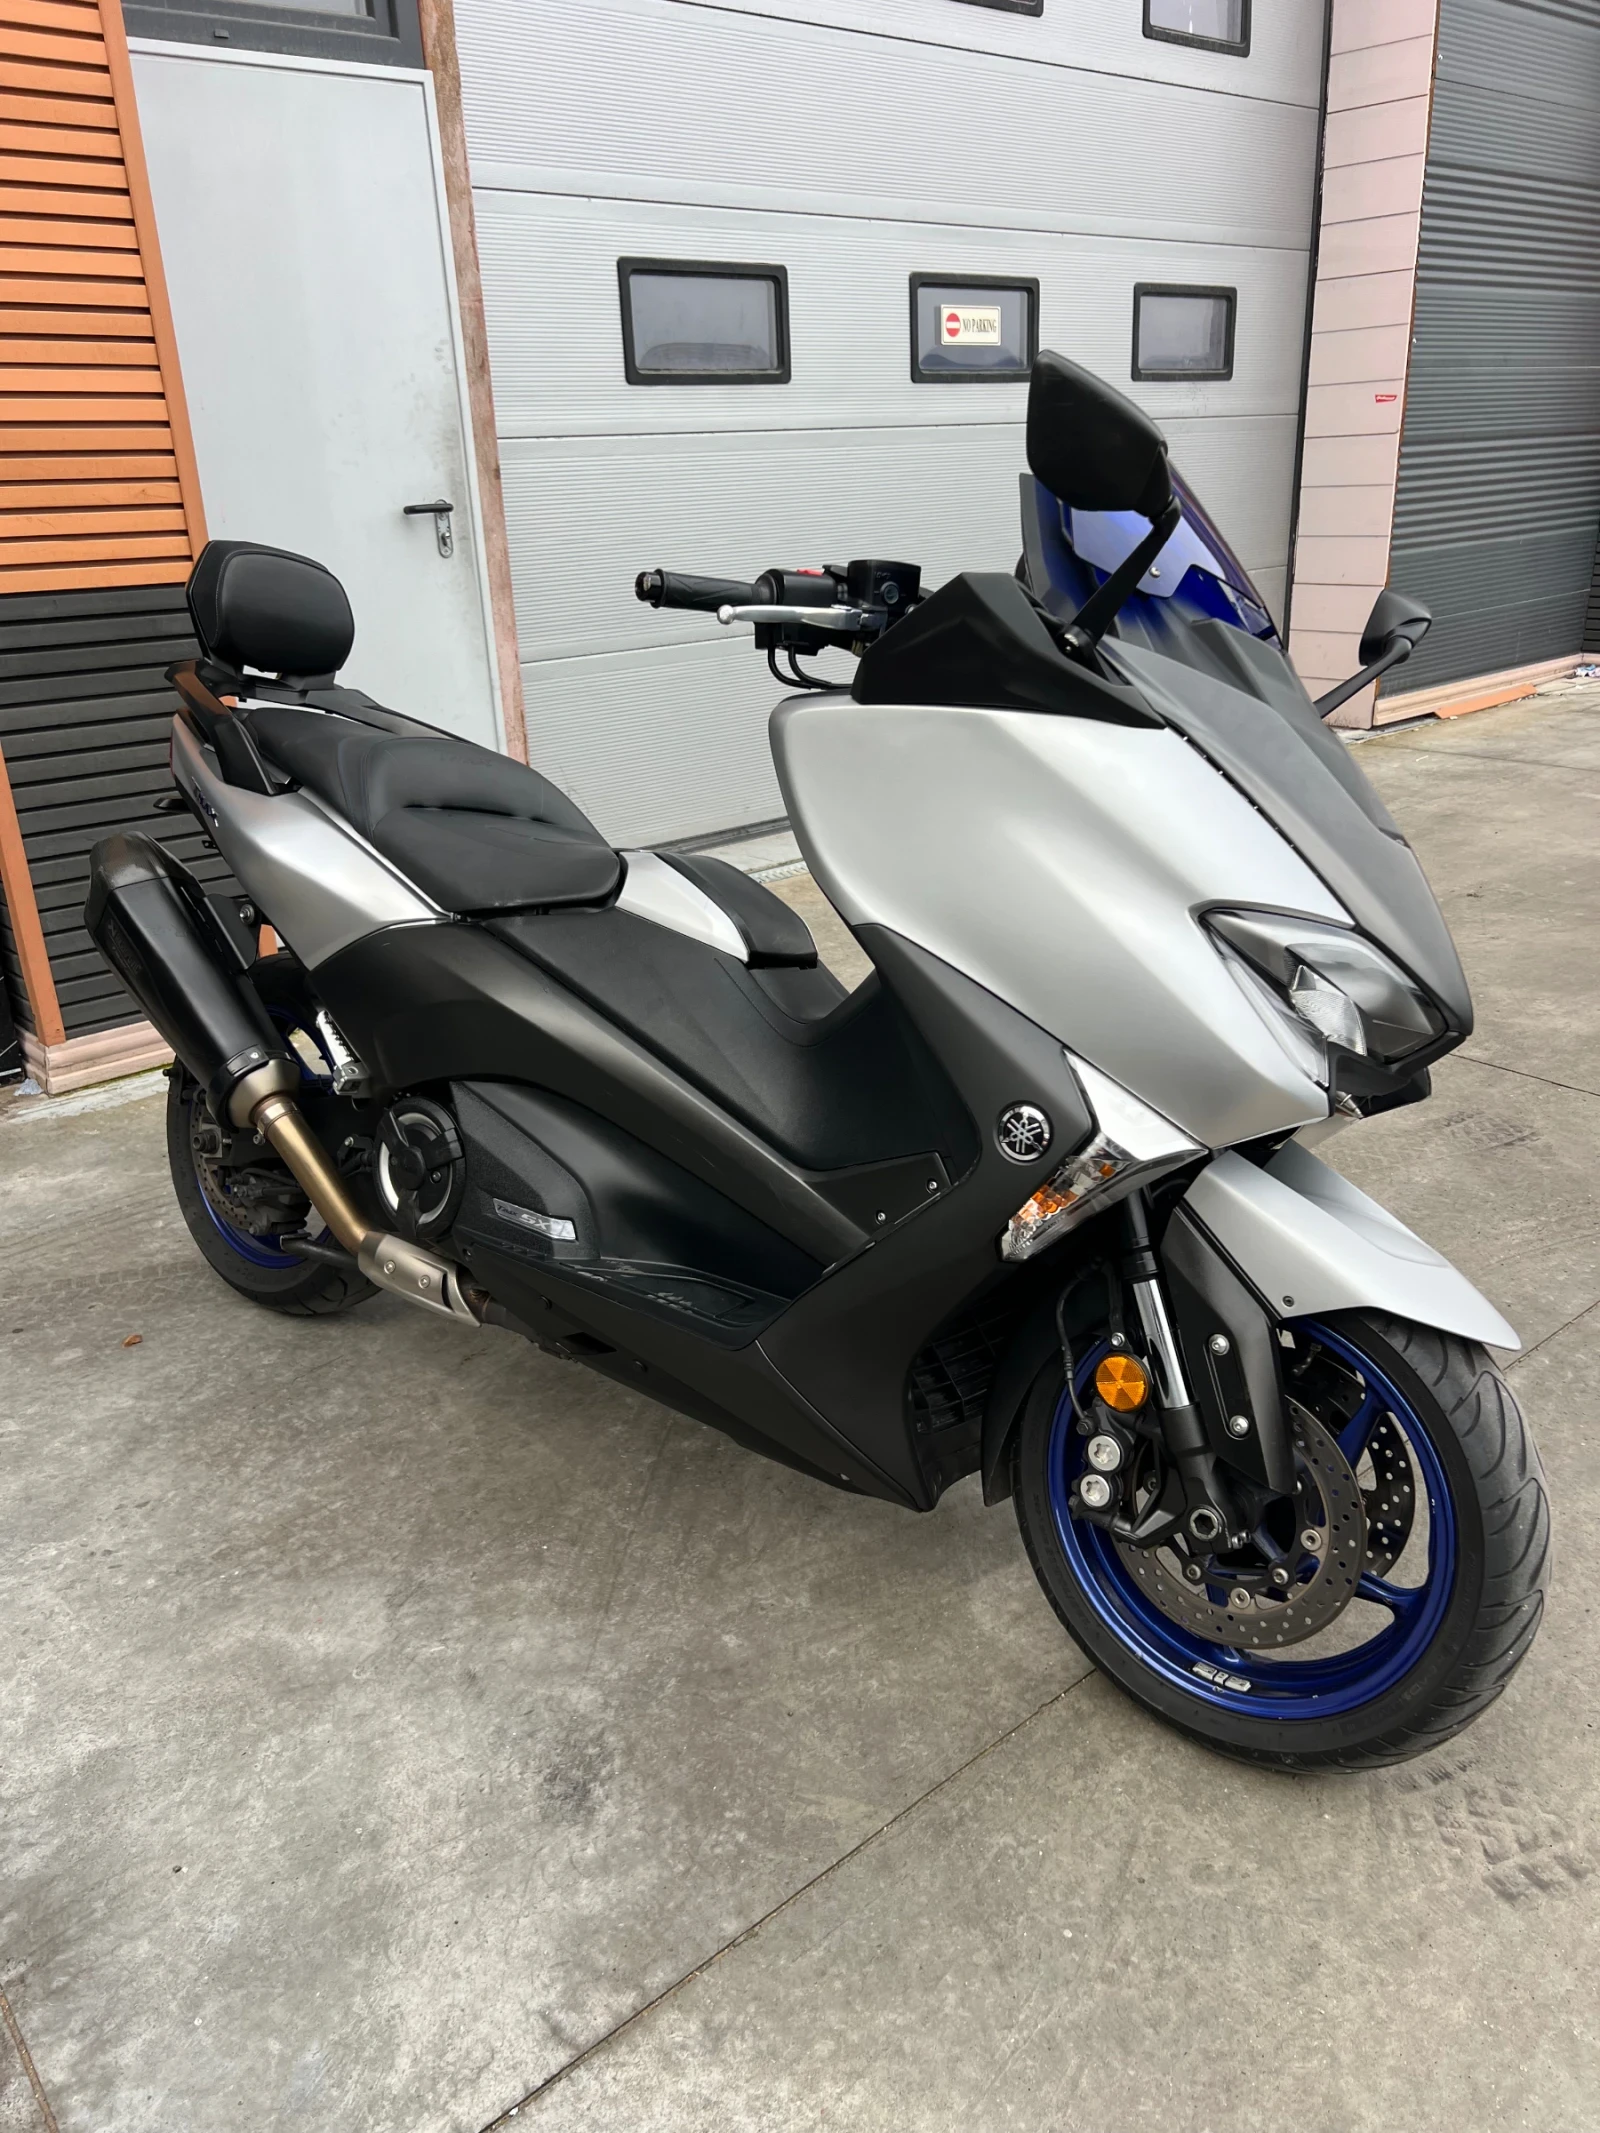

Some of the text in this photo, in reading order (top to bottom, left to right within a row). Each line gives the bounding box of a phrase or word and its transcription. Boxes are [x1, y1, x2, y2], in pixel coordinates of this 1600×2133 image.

[962, 318, 997, 333] NO PARKING
[519, 1213, 551, 1230] SX
